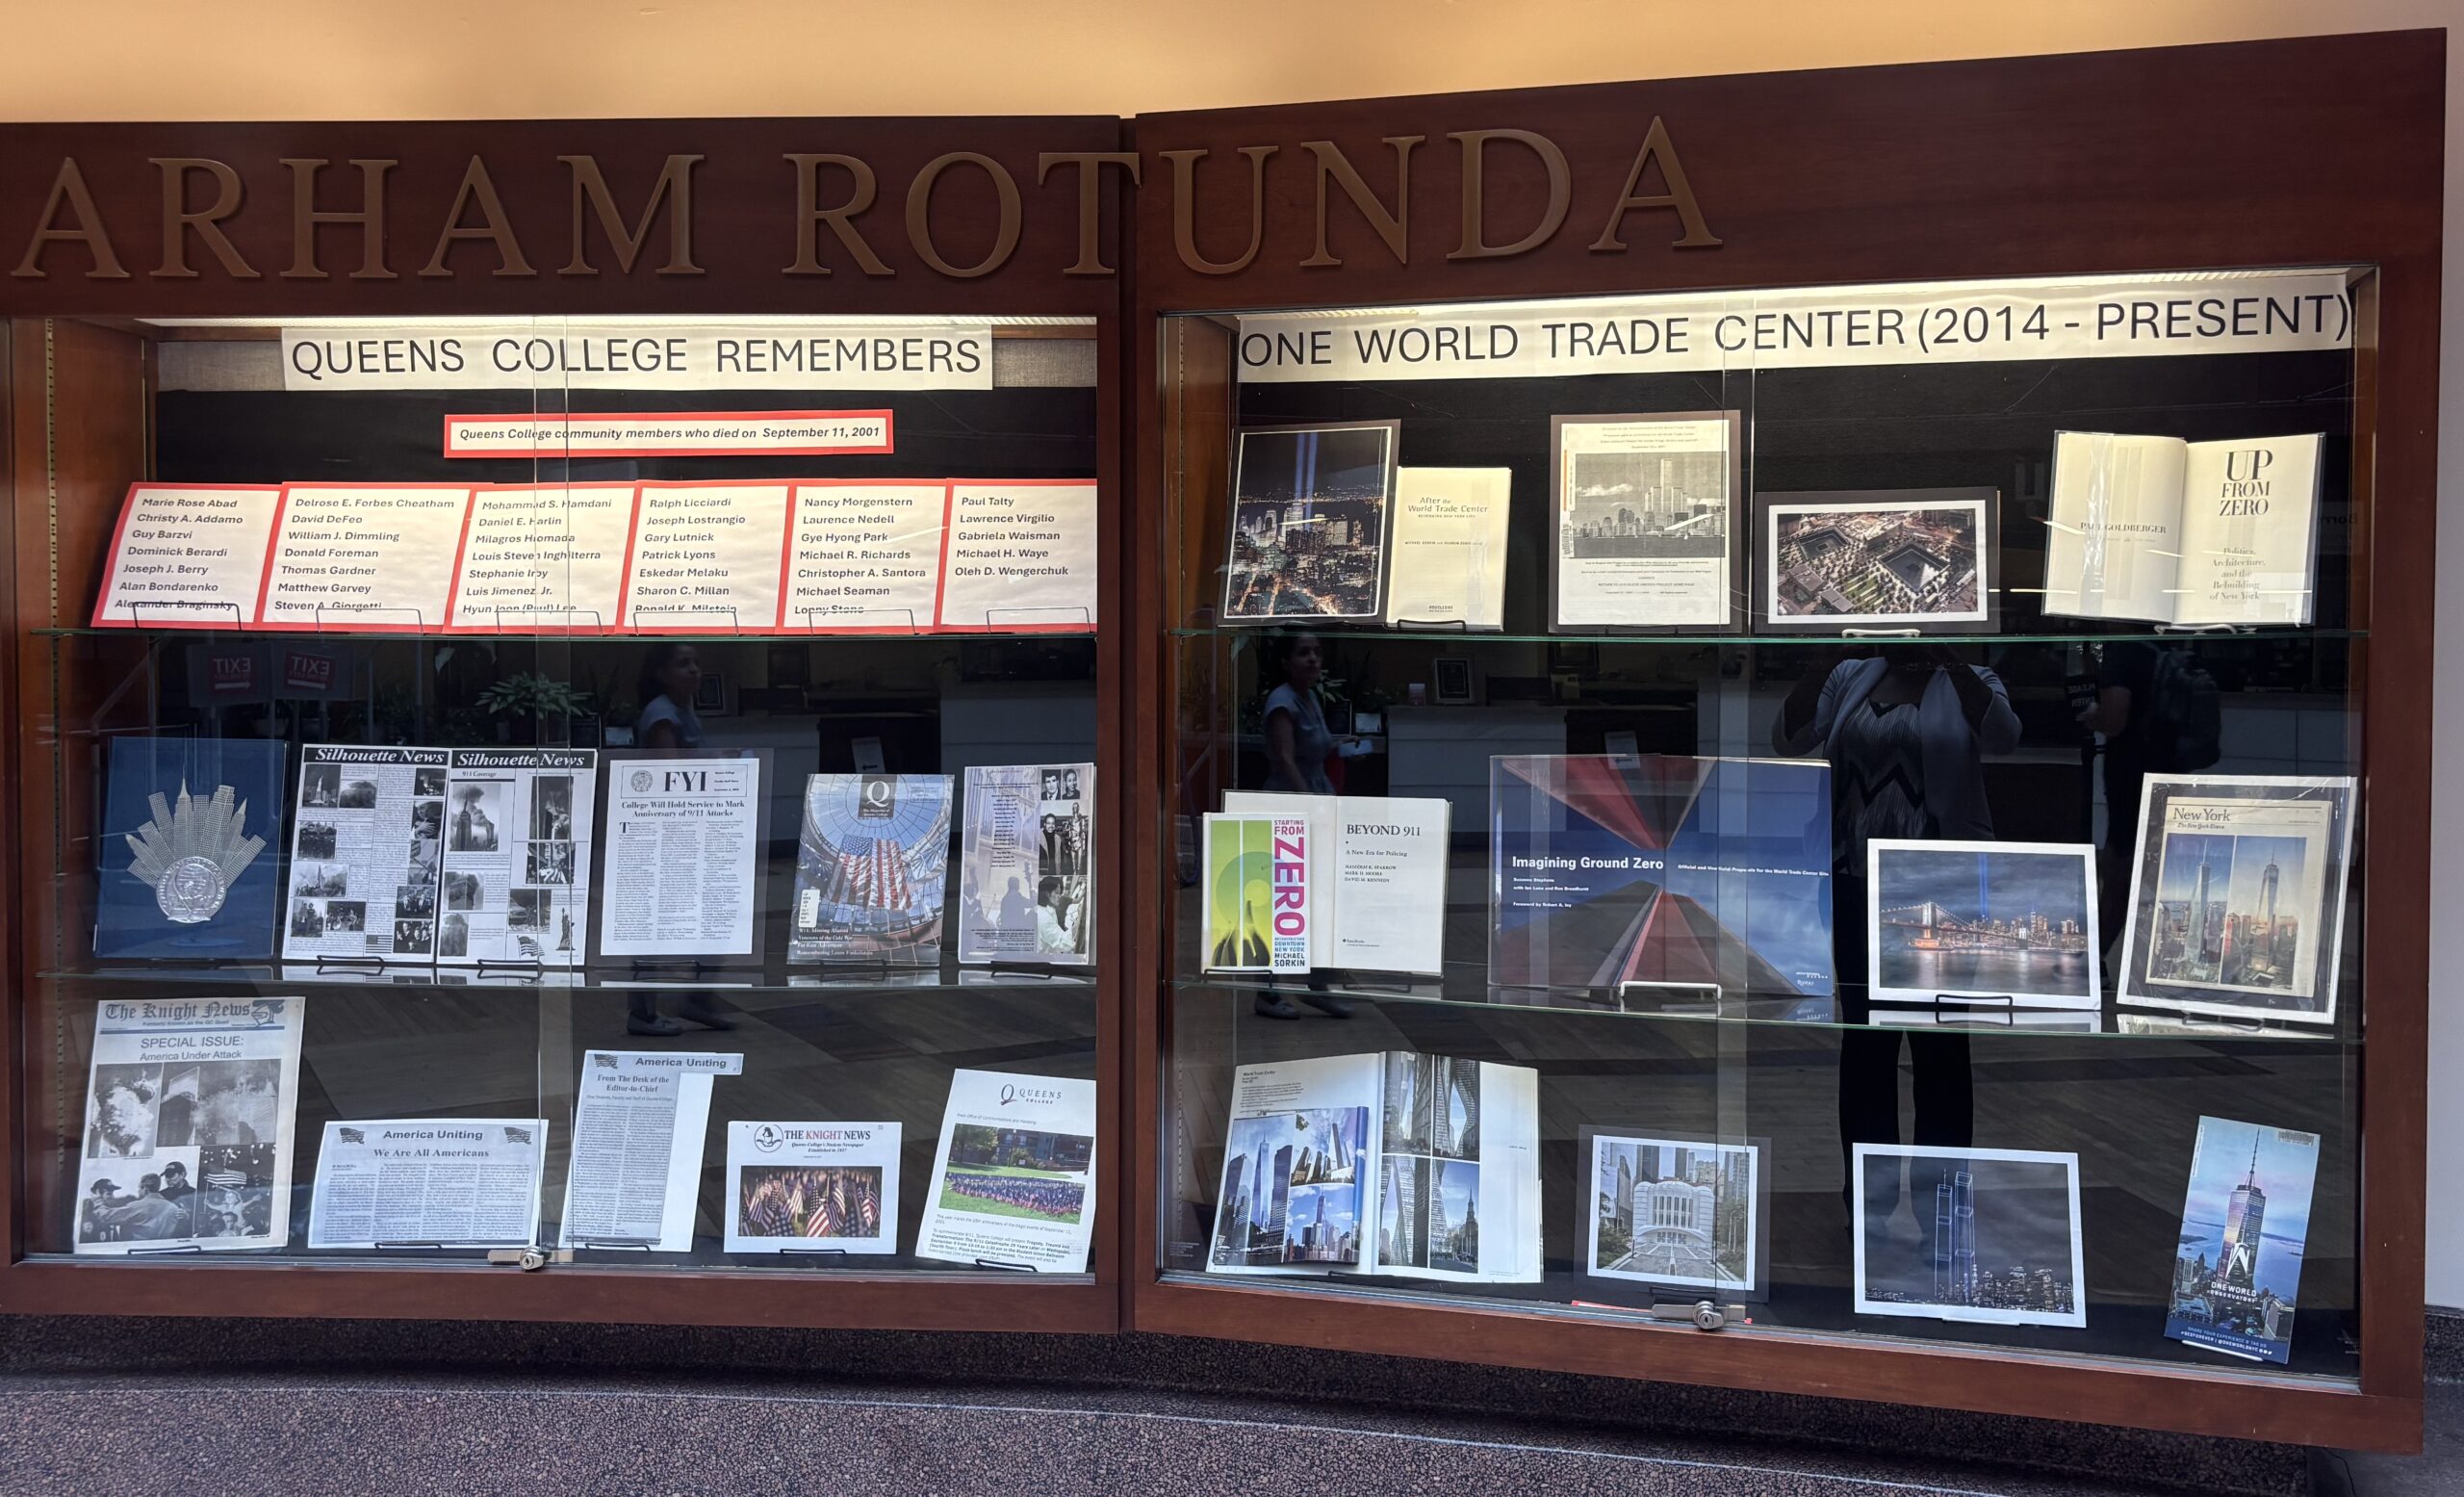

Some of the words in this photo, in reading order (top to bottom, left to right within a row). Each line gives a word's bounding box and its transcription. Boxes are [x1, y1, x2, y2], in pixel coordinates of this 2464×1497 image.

[10, 154, 706, 278] ARHAM
[782, 116, 1724, 277] ROTUNDA
[1242, 331, 1332, 367] ONE
[1354, 324, 1518, 364] WORLD
[1542, 317, 1689, 359] TRADE
[1715, 309, 1905, 350] CENTER
[1918, 305, 2049, 353] (2014
[2097, 294, 2348, 341] PRESENT)
[293, 339, 464, 380] QUEENS
[492, 338, 687, 373] COLLEGE
[717, 339, 981, 373] REMEMBERS
[460, 429, 504, 440] Queens
[508, 428, 552, 441] College
[554, 428, 622, 441] community
[626, 427, 682, 439] members
[685, 429, 710, 438] who
[713, 428, 740, 438] died
[763, 427, 828, 440] September
[832, 428, 849, 438] 11,
[852, 426, 879, 437] 2001
[2225, 450, 2273, 481] UP
[2221, 481, 2270, 498] FROM
[142, 499, 174, 507] Marie
[178, 499, 205, 507] Rose
[208, 499, 238, 507] Abad
[295, 499, 339, 507] Delrose
[343, 499, 351, 507] E.
[355, 499, 393, 507] Forbes
[397, 499, 454, 508] Cheatham
[650, 499, 681, 509] Ralph
[684, 499, 731, 507] Licciardi
[805, 498, 839, 508] Nancy
[842, 498, 912, 507] Morgenstern
[962, 498, 986, 506] Paul
[988, 498, 1014, 507] Talty
[2220, 499, 2269, 516] ZERO
[137, 514, 178, 525] Christy
[194, 515, 243, 524] Addamo
[292, 515, 324, 524] David
[327, 515, 362, 524] DeFeo
[647, 516, 685, 526] Joseph
[688, 515, 745, 526] Lostrangio
[960, 514, 1013, 523] Lawrence
[1016, 514, 1055, 525] Virgilio
[132, 530, 156, 540] Guy
[158, 529, 192, 539] Barzvi
[289, 531, 331, 540] William
[334, 531, 342, 540] J.
[345, 531, 399, 542] Dimmling
[645, 533, 671, 544] Gary
[801, 533, 823, 543] Gye
[826, 533, 861, 543] Hyong
[864, 532, 888, 542] Park
[1008, 531, 1060, 540] Waisman
[128, 547, 183, 556] Dominick
[186, 548, 227, 557] Berardi
[285, 548, 325, 557] Donald
[328, 549, 378, 557] Foreman
[642, 551, 680, 559] Patrick
[683, 551, 715, 561] Lyons
[800, 551, 844, 559] Michael
[847, 551, 858, 559] R.
[860, 551, 911, 559] Richards
[957, 549, 1001, 558] Michael
[1004, 550, 1014, 558] H.
[1018, 550, 1048, 559] Waye
[123, 564, 163, 576] Joseph
[166, 564, 174, 574] J.
[178, 564, 208, 576] Berry
[281, 566, 326, 575] Thomas
[330, 566, 376, 575] Gardner
[640, 568, 684, 578] Eskedar
[687, 568, 729, 578] Melaku
[798, 568, 865, 579] Christopher
[868, 569, 879, 578] A.
[955, 566, 981, 576] Oleh
[985, 567, 995, 576] D.
[998, 566, 1068, 578] Wengerchuk
[119, 582, 146, 592] Alan
[149, 582, 218, 592] Bondarenko
[278, 583, 328, 592] Matthew
[331, 583, 372, 595] Garvey
[467, 587, 489, 596] Luis
[491, 586, 535, 596] Jimenez
[541, 586, 552, 595] Jr.
[637, 586, 678, 595] Sharon
[680, 586, 691, 595] C.
[695, 586, 730, 595] Millan
[797, 586, 840, 596] Michael
[843, 586, 889, 596] Seaman
[316, 749, 397, 761] Silhouette
[398, 750, 445, 762] News
[457, 754, 537, 766] Silhouette
[539, 754, 584, 766] News
[663, 771, 708, 791] FYI
[866, 781, 889, 807] Q
[632, 810, 676, 818] Anniversary
[2173, 808, 2201, 820] New
[2203, 809, 2231, 821] York
[1348, 824, 1400, 836] BEYOND
[1403, 826, 1421, 836] 911
[1513, 856, 1577, 870] Imagining
[1580, 857, 1629, 869] Ground
[1633, 858, 1664, 869] Zero
[1274, 838, 1305, 936] ZERO
[105, 1004, 137, 1021] The
[143, 1002, 197, 1020] Knight
[202, 1001, 250, 1018] News
[141, 1038, 196, 1047] SPECIAL
[201, 1037, 244, 1046] ISSUE:
[140, 1052, 179, 1061] America
[635, 1058, 681, 1067] America
[686, 1059, 727, 1068] Uniting
[1019, 1088, 1062, 1098] QUEENS
[383, 1130, 433, 1139] America
[438, 1130, 482, 1140] Uniting
[784, 1130, 804, 1139] THE
[807, 1131, 842, 1140] KNIGHT
[844, 1131, 870, 1140] NEWS
[414, 1149, 429, 1157] All
[433, 1149, 489, 1157] Americans
[2227, 1285, 2256, 1297] WORLD
